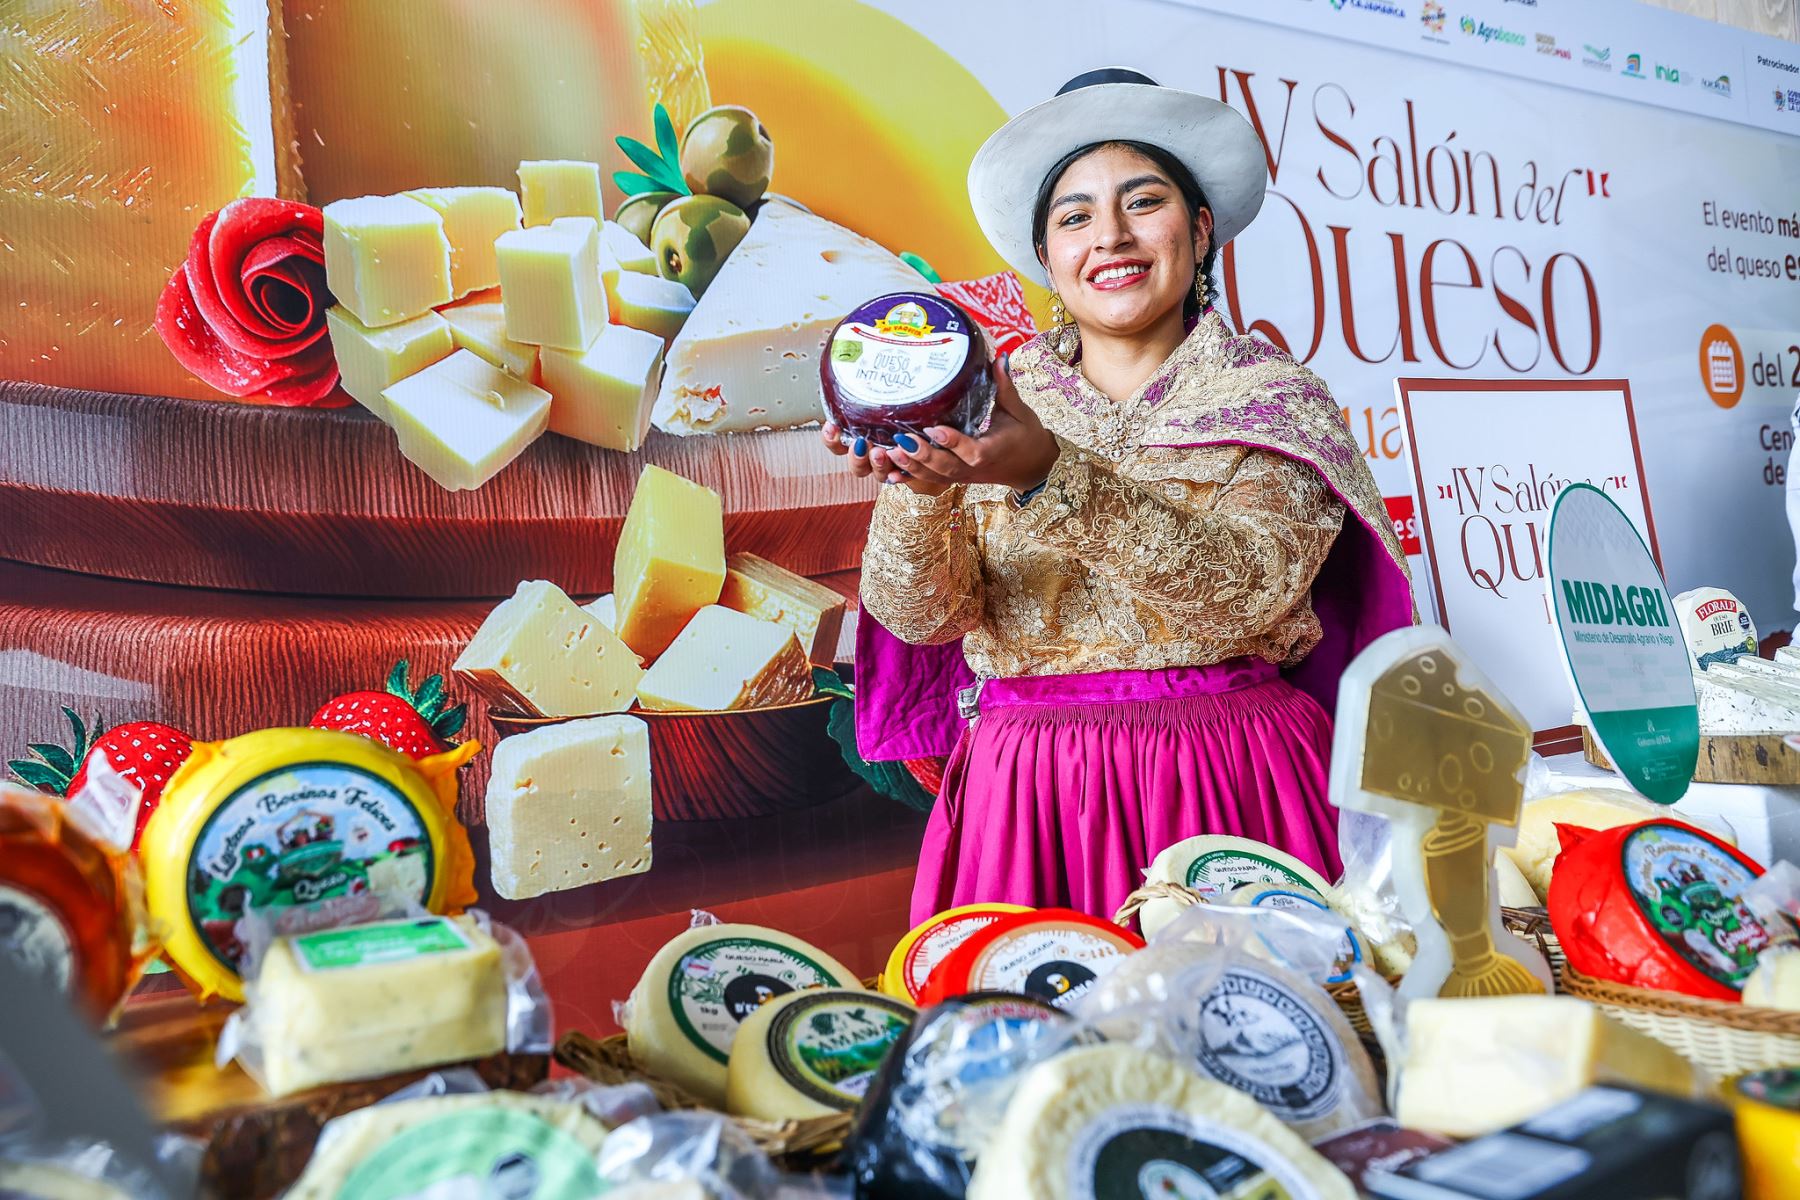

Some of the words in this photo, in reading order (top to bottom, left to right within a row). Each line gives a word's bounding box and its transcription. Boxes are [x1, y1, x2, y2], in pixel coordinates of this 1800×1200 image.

[1312, 82, 1504, 220] Salón
[1515, 160, 1583, 226] del
[1703, 200, 1719, 227] El
[1722, 209, 1775, 235] evento
[1778, 211, 1800, 239] má
[1707, 245, 1733, 274] del
[1736, 255, 1781, 280] queso
[1222, 189, 1601, 377] Queso
[856, 369, 878, 381] INTI
[873, 352, 911, 372] QUESO
[1752, 351, 1785, 388] del
[1759, 424, 1796, 452] Cen
[1763, 457, 1786, 486] de
[1452, 467, 1485, 515] IV
[1460, 514, 1546, 600] Qu
[1561, 579, 1670, 628] MIDAGRI
[1698, 600, 1736, 620] FLORALP
[1609, 632, 1636, 644] Desarrollo
[1711, 620, 1736, 636] BRIE
